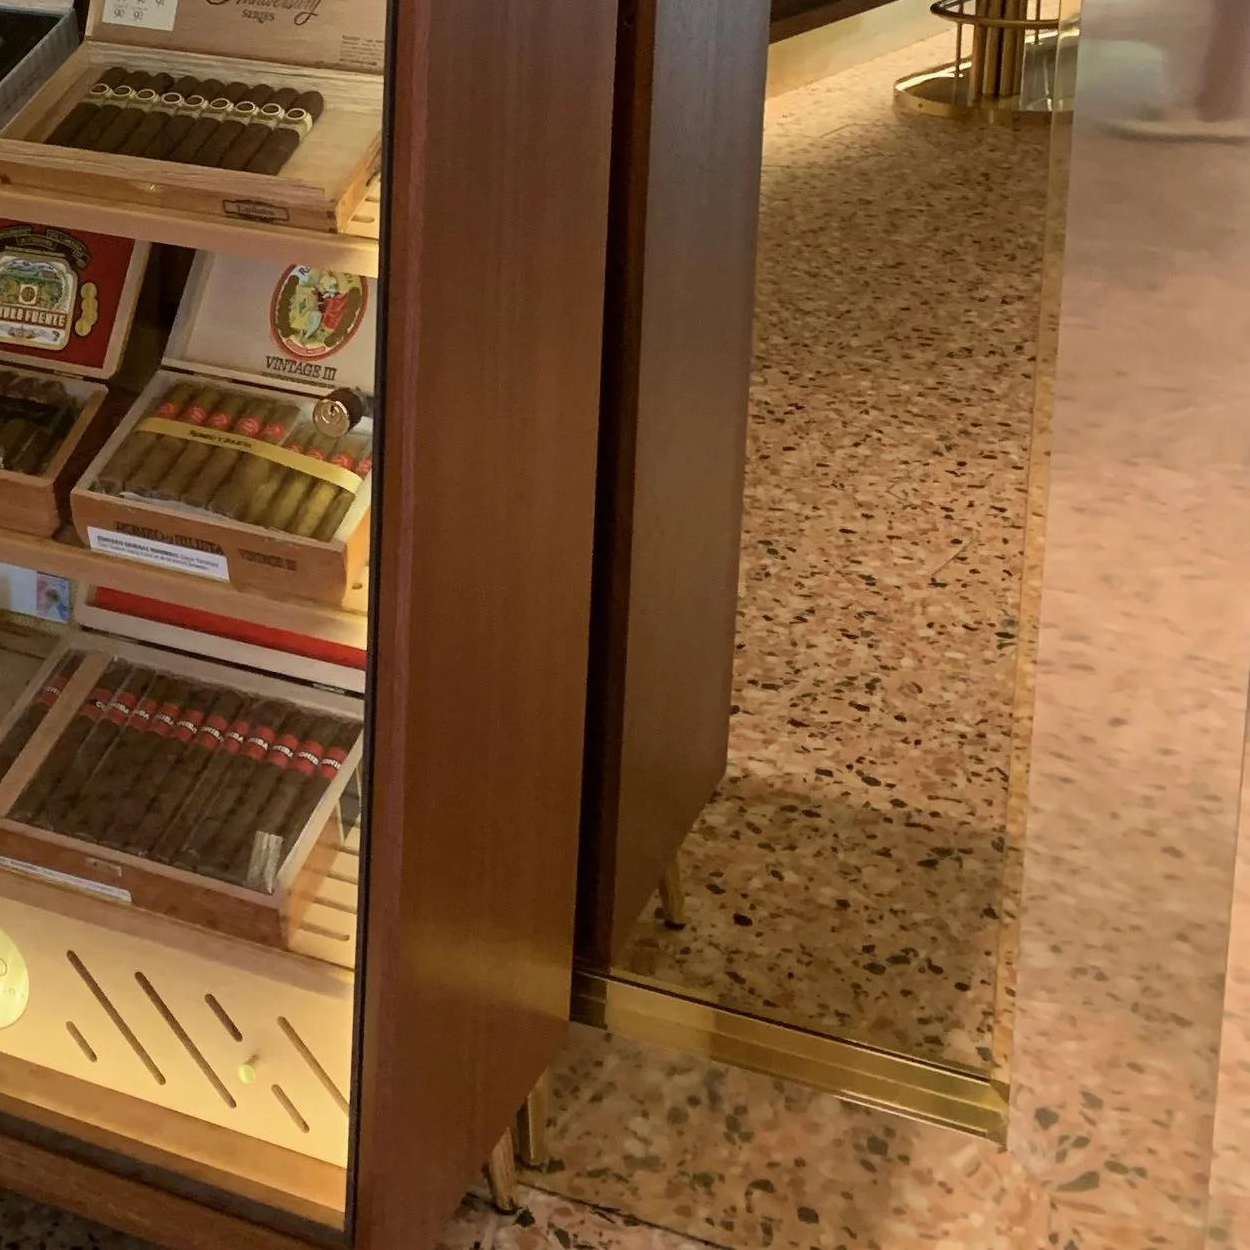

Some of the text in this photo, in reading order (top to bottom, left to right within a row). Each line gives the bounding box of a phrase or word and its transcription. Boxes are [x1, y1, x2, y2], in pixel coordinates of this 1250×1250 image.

[25, 308, 66, 326] FUENTE
[265, 356, 338, 380] VINTAGE III
